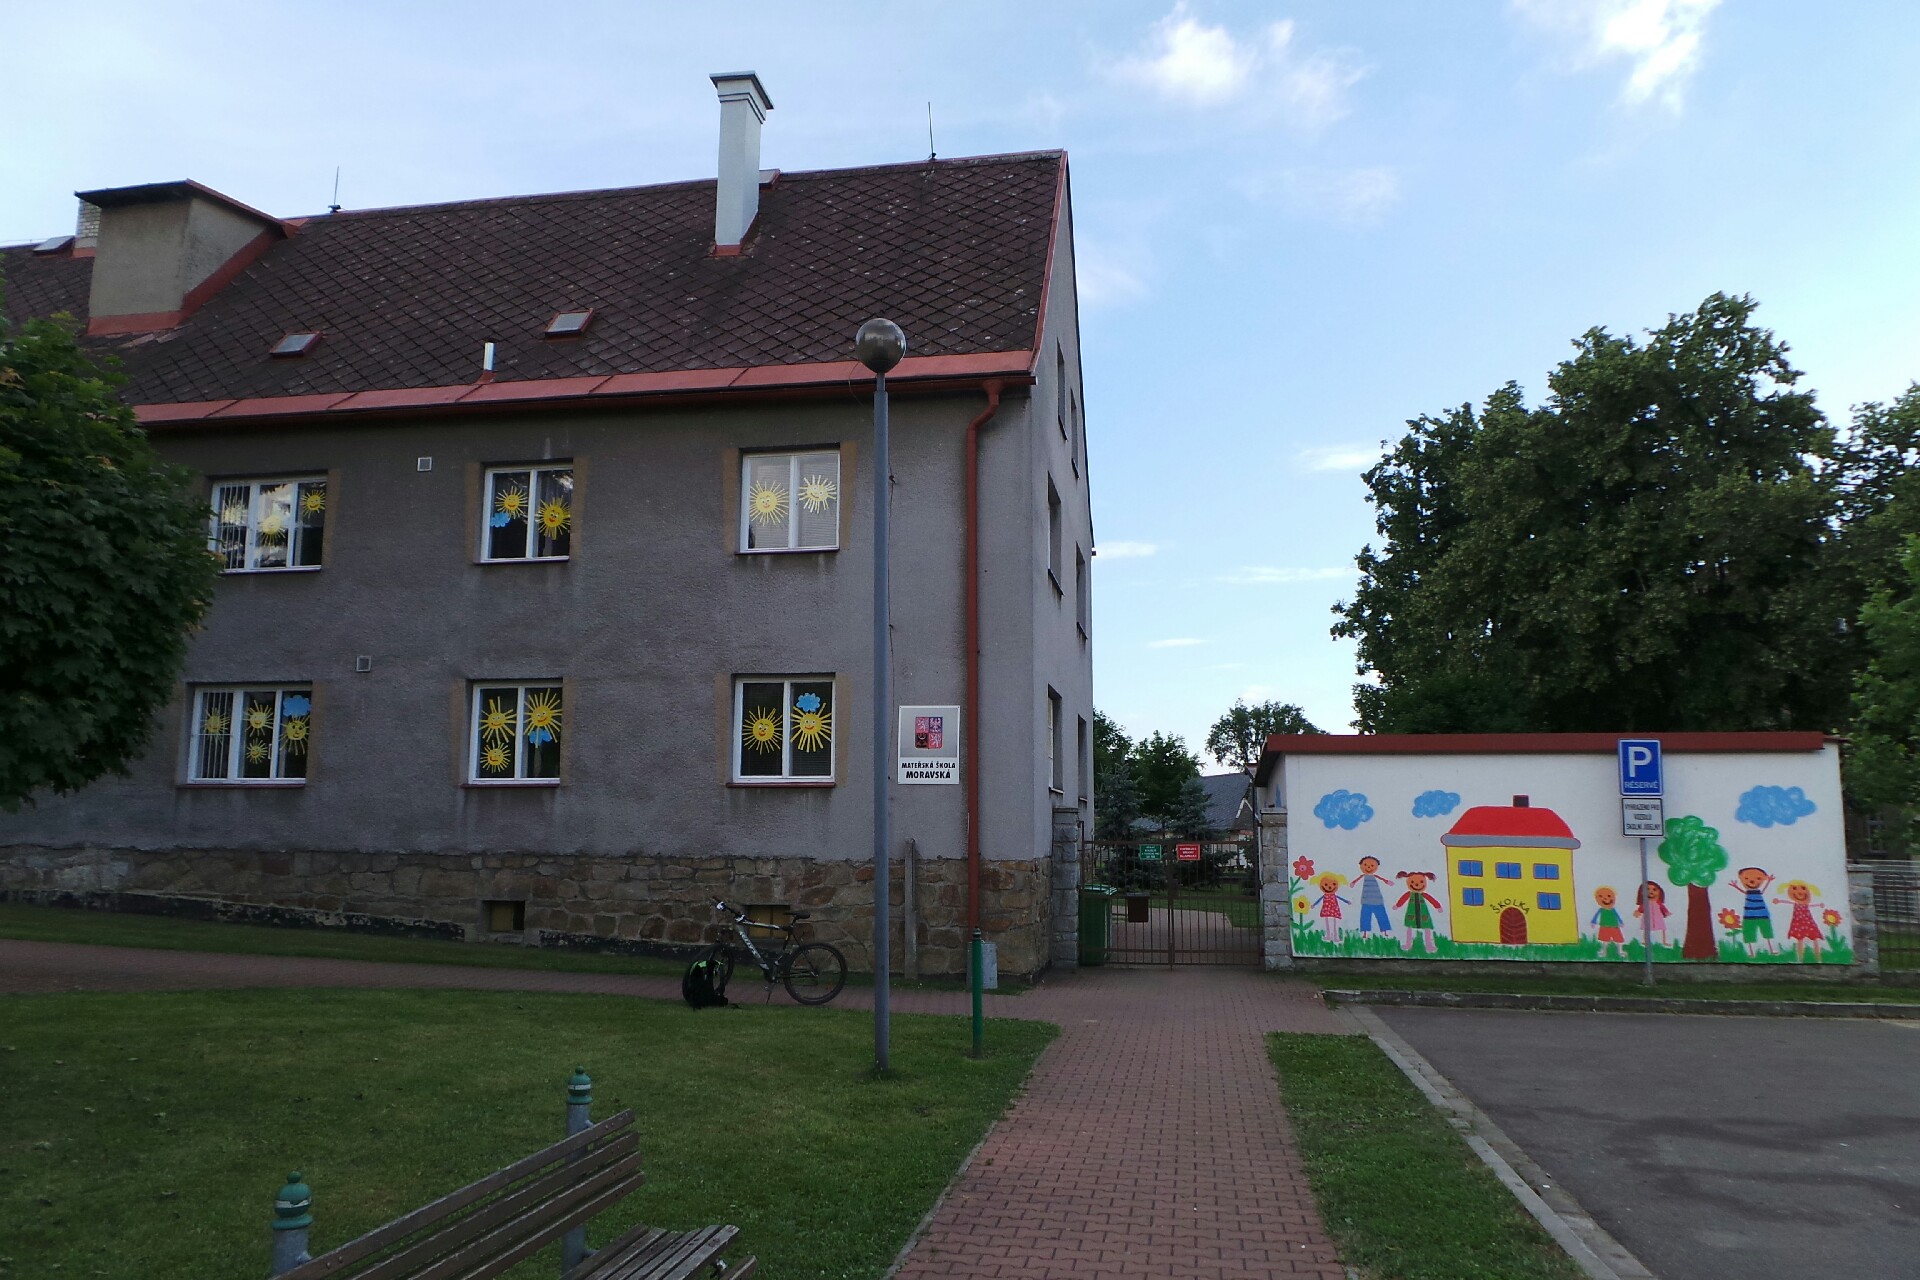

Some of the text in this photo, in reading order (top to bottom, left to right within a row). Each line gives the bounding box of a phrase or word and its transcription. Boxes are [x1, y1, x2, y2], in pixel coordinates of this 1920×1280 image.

[901, 761, 956, 769] MATEŘSKÁ ŠKOLA
[1628, 746, 1652, 778] P
[906, 769, 951, 779] MORAVSKÁ
[1624, 780, 1659, 789] RÉSERVÉ
[1490, 898, 1530, 914] ŠKOLKA
